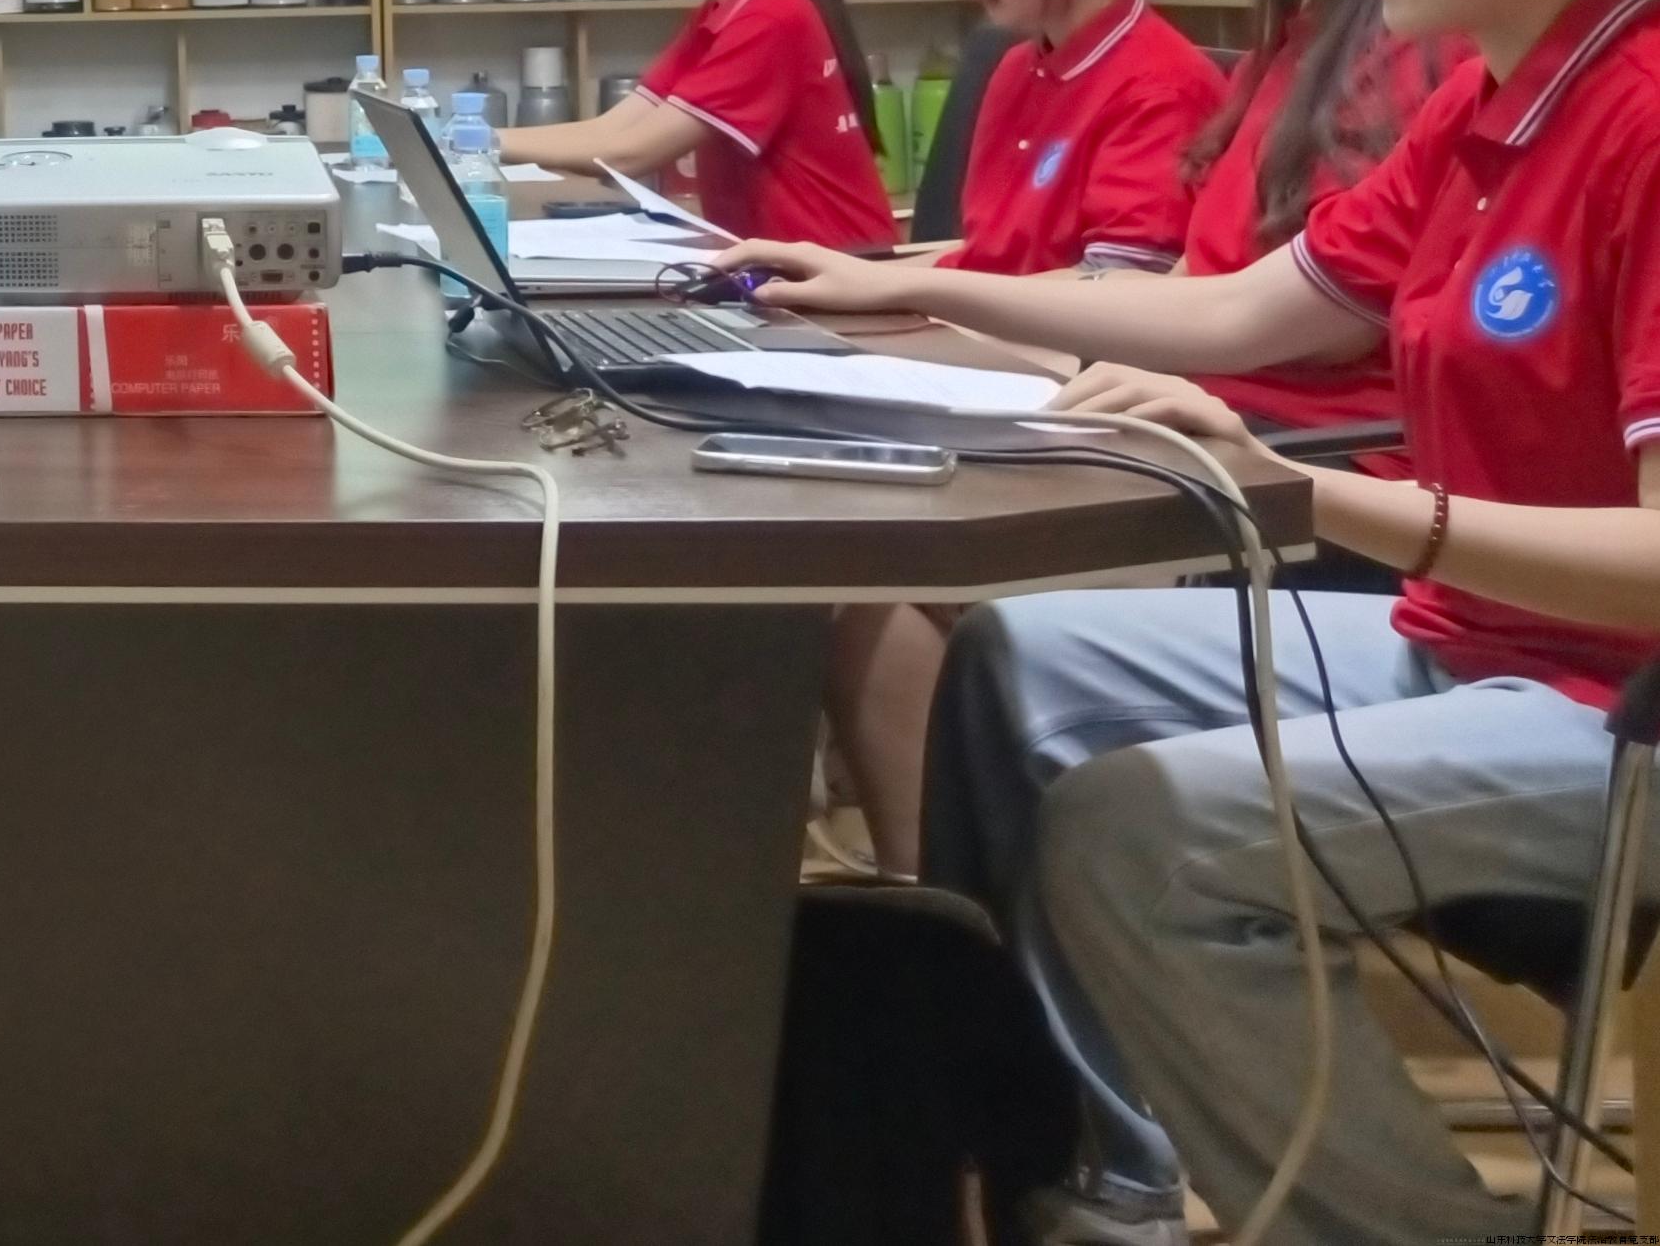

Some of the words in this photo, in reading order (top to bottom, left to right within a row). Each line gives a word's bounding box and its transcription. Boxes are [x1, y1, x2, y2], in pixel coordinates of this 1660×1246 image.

[5, 379, 48, 396] CHOICE
[111, 382, 178, 394] COMPUTER
[180, 382, 221, 394] PAPER
